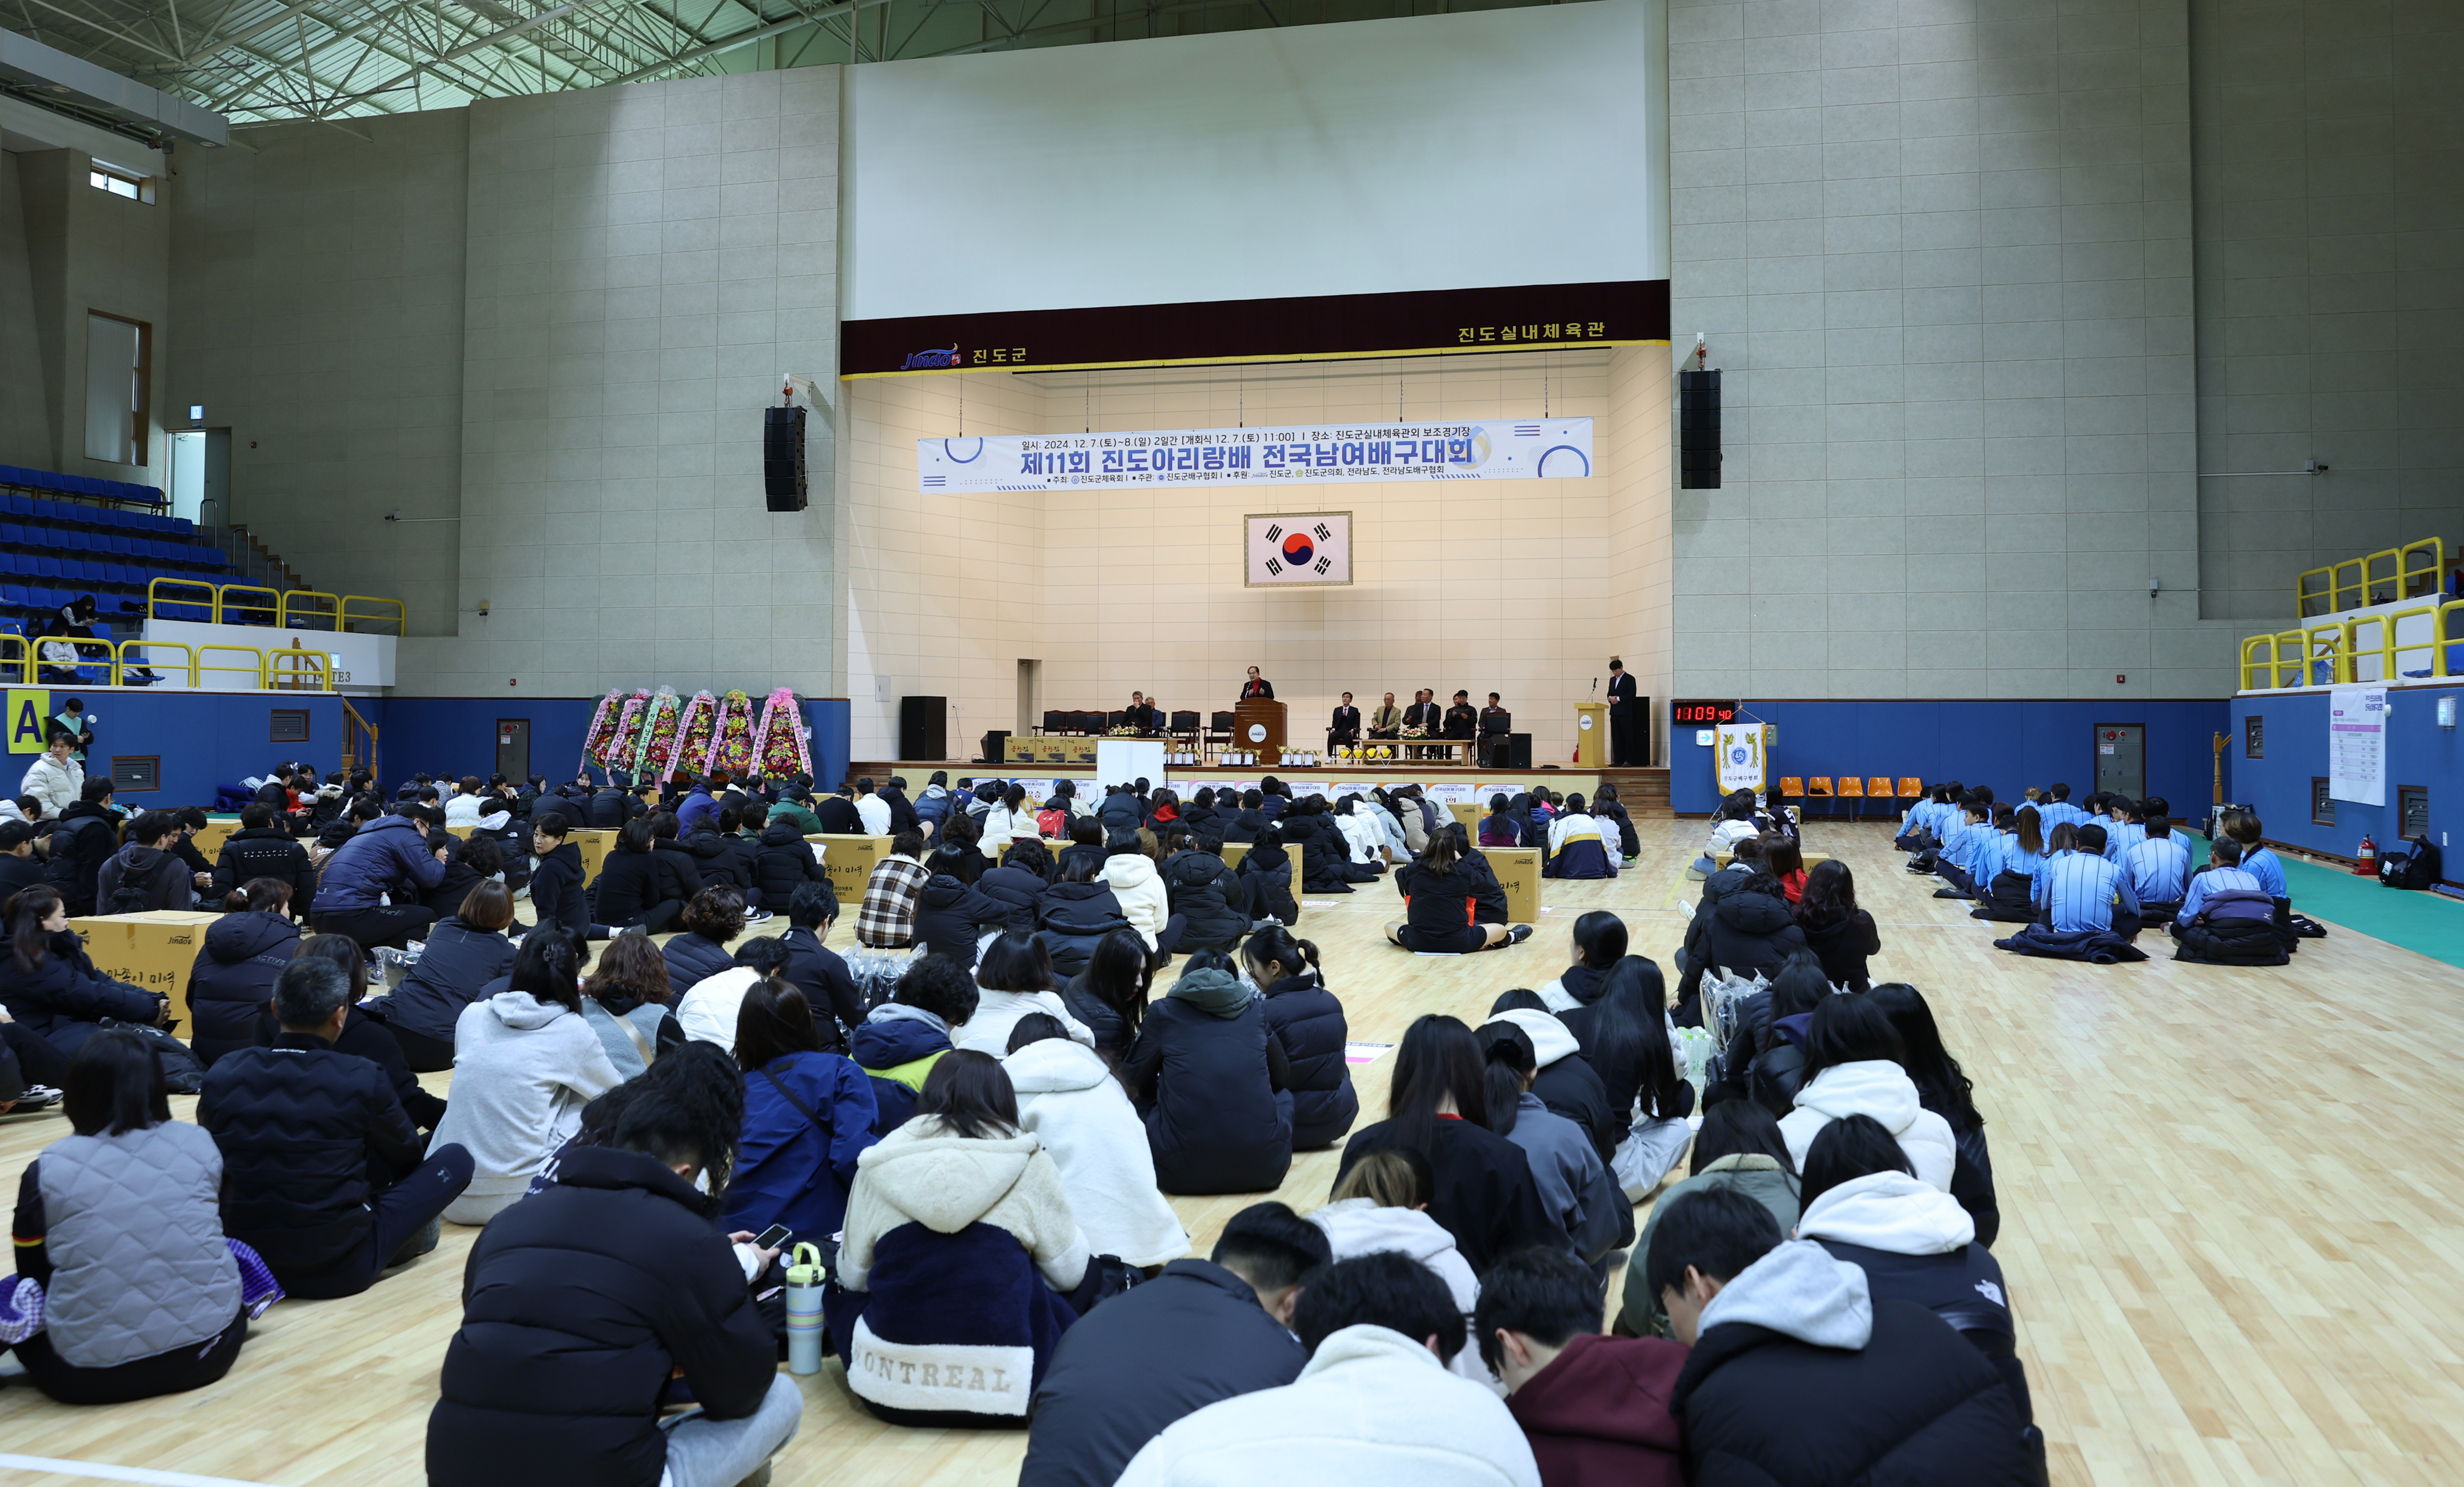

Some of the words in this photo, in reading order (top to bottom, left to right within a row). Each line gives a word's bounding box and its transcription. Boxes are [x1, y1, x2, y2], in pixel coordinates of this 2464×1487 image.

[1458, 321, 1605, 343] 진도실내체육관
[901, 350, 951, 370] Jindo
[973, 348, 1026, 364] 진도군
[1022, 441, 1041, 451] 일시:
[1044, 440, 1071, 449] 2024.
[1074, 439, 1088, 448] 12.
[1154, 436, 1178, 446] 2일간
[1182, 434, 1212, 446] [개회식
[1216, 434, 1230, 444] 12.
[1233, 432, 1260, 443] 7.(토)
[1264, 431, 1295, 442] 11:00]
[1311, 431, 1332, 441] 장소:
[1335, 427, 1420, 440] 진도군실내체육관외
[1423, 426, 1471, 437] 보조경기장
[1021, 450, 1090, 475] 제11회
[1102, 445, 1251, 473] 진도아리랑배
[1263, 439, 1472, 469] 전국남여배구대회
[1081, 474, 1123, 483] 진도군체육회
[1138, 474, 1155, 482] 주관:
[1166, 471, 1218, 481] 진도군배구협회
[1232, 471, 1250, 479] 후원:
[1269, 469, 1293, 478] 진도군,
[1305, 468, 1344, 477] 진도군의회,
[1347, 468, 1380, 476] 전라남도,
[1382, 466, 1444, 475] 전라남도배구협회
[315, 671, 351, 682] GTE3
[14, 699, 43, 743] A
[845, 865, 862, 877] 미역
[1499, 881, 1519, 893] 미역
[167, 935, 188, 945] Jindo
[149, 971, 174, 991] 미역
